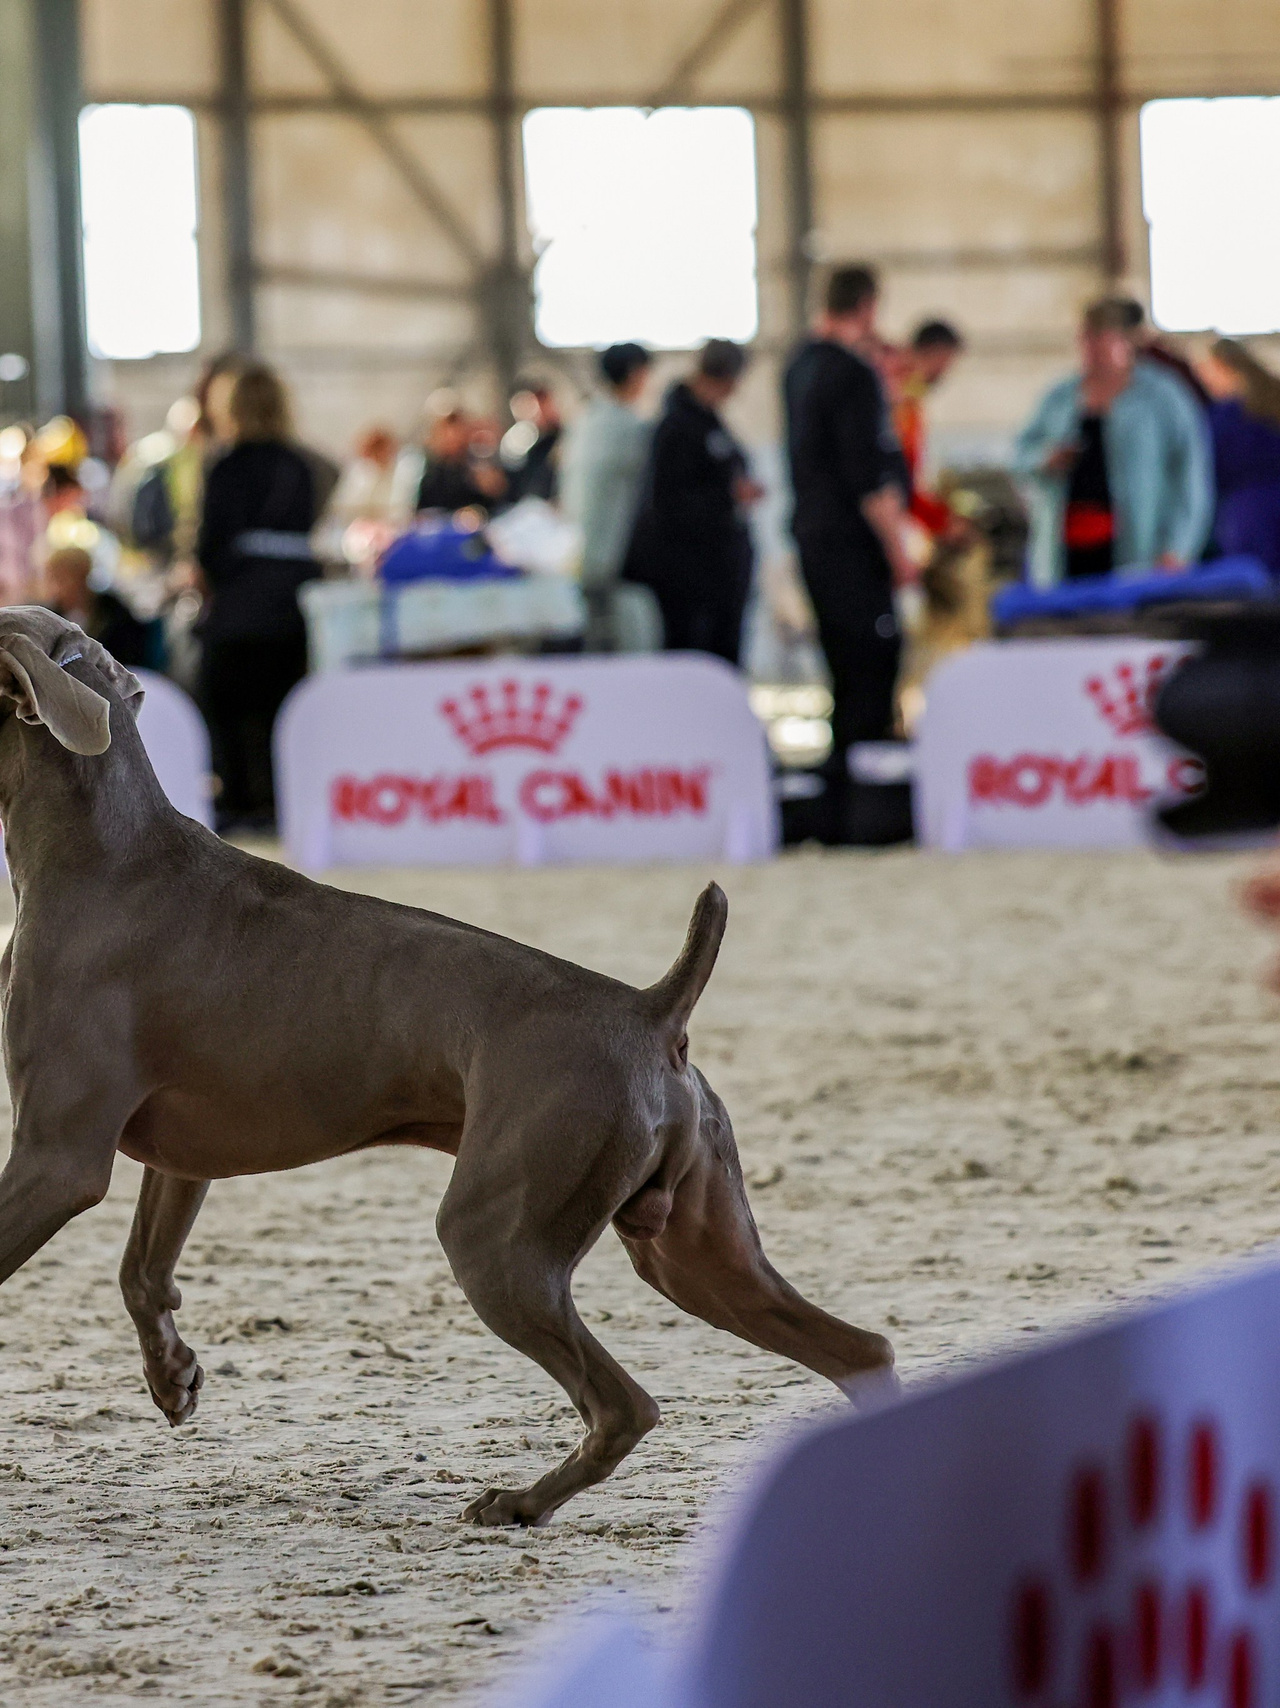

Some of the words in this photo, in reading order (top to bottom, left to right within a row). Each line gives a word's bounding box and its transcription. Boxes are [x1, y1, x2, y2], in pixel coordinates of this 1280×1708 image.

[329, 771, 504, 826] ROYAL
[518, 765, 710, 823] CANIN
[967, 752, 1152, 808] ROYAL
